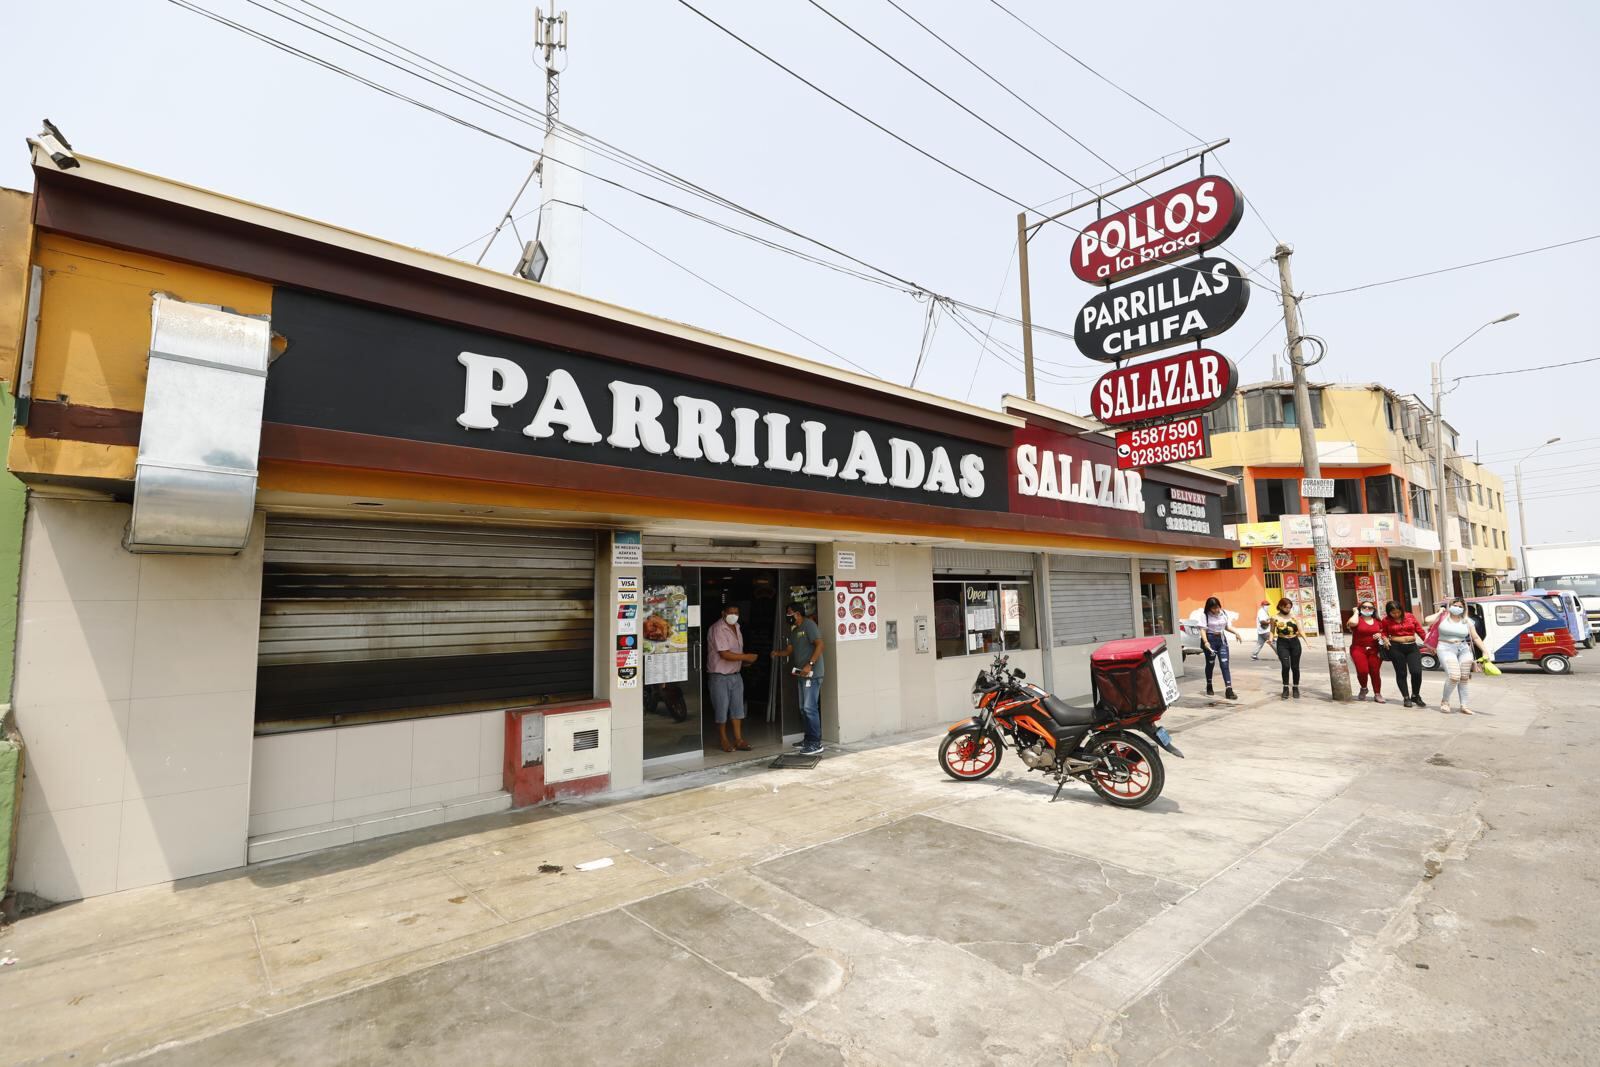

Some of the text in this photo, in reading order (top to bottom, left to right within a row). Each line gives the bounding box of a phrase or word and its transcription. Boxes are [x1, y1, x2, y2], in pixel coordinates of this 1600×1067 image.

[1080, 181, 1218, 267] POLLOS
[1096, 231, 1200, 278] a la brasa
[1083, 262, 1230, 333] PARRILLAS
[1102, 309, 1208, 355] CHIFA
[1100, 355, 1222, 420] SALAZAR
[456, 351, 986, 499] PARRILLADAS
[1131, 420, 1198, 447] 5587590
[1131, 439, 1205, 467] 928385051
[1016, 444, 1146, 514] SALAZAR
[1170, 488, 1206, 505] DELIVERY
[966, 586, 987, 603] Open
